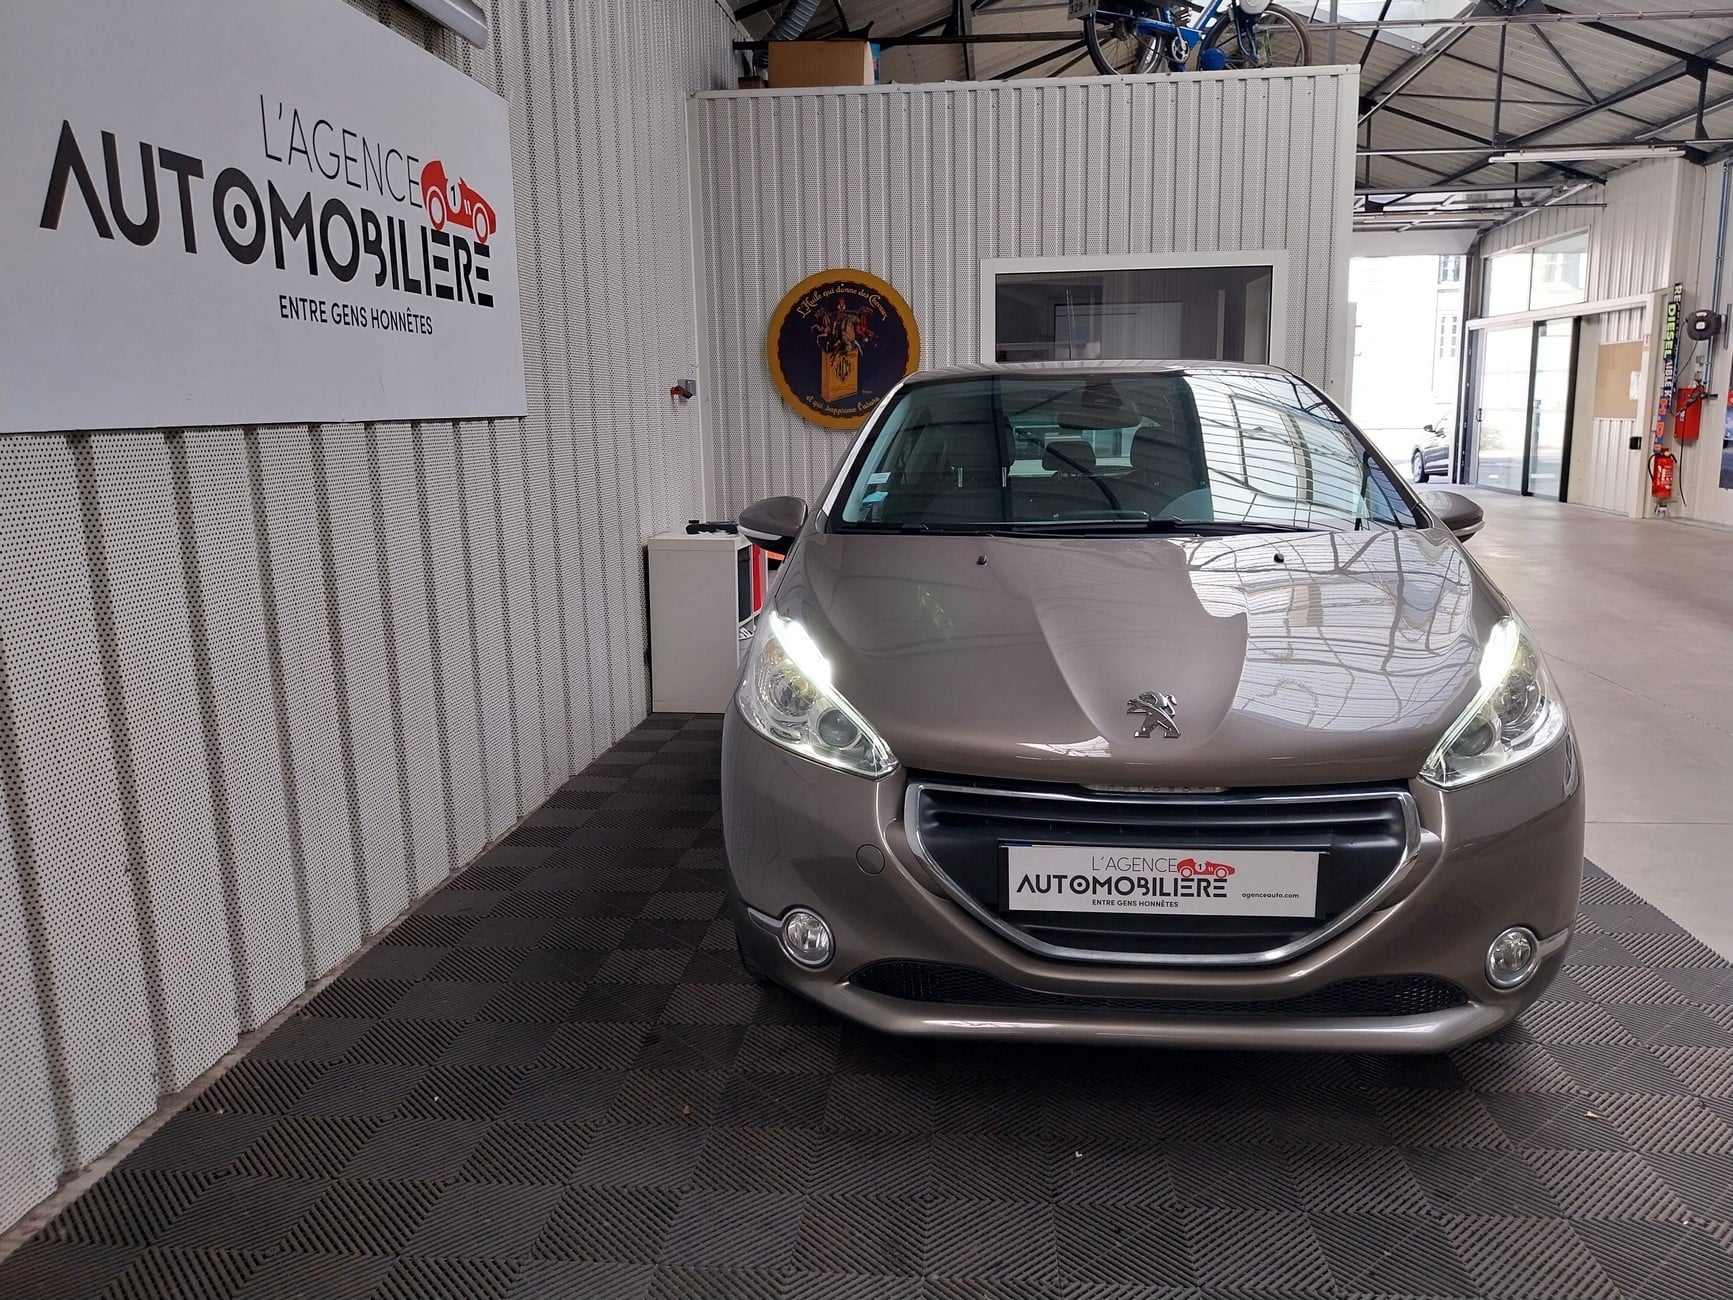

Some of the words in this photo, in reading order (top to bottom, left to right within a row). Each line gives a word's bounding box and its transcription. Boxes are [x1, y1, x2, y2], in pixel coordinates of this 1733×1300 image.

[259, 94, 423, 209] L'AGENCE
[450, 185, 457, 207] 1
[822, 287, 835, 297] qui
[835, 286, 857, 294] donne
[858, 288, 869, 298] des
[279, 294, 328, 323] ENTRE
[331, 302, 368, 328] GENS
[371, 306, 433, 335] HONNÊTES
[1664, 303, 1676, 358] DIESEL
[1664, 360, 1674, 387] AIBLE
[812, 400, 824, 409] qui
[1092, 856, 1178, 873] L'AGENCE
[1138, 900, 1179, 908] HONNÊTES
